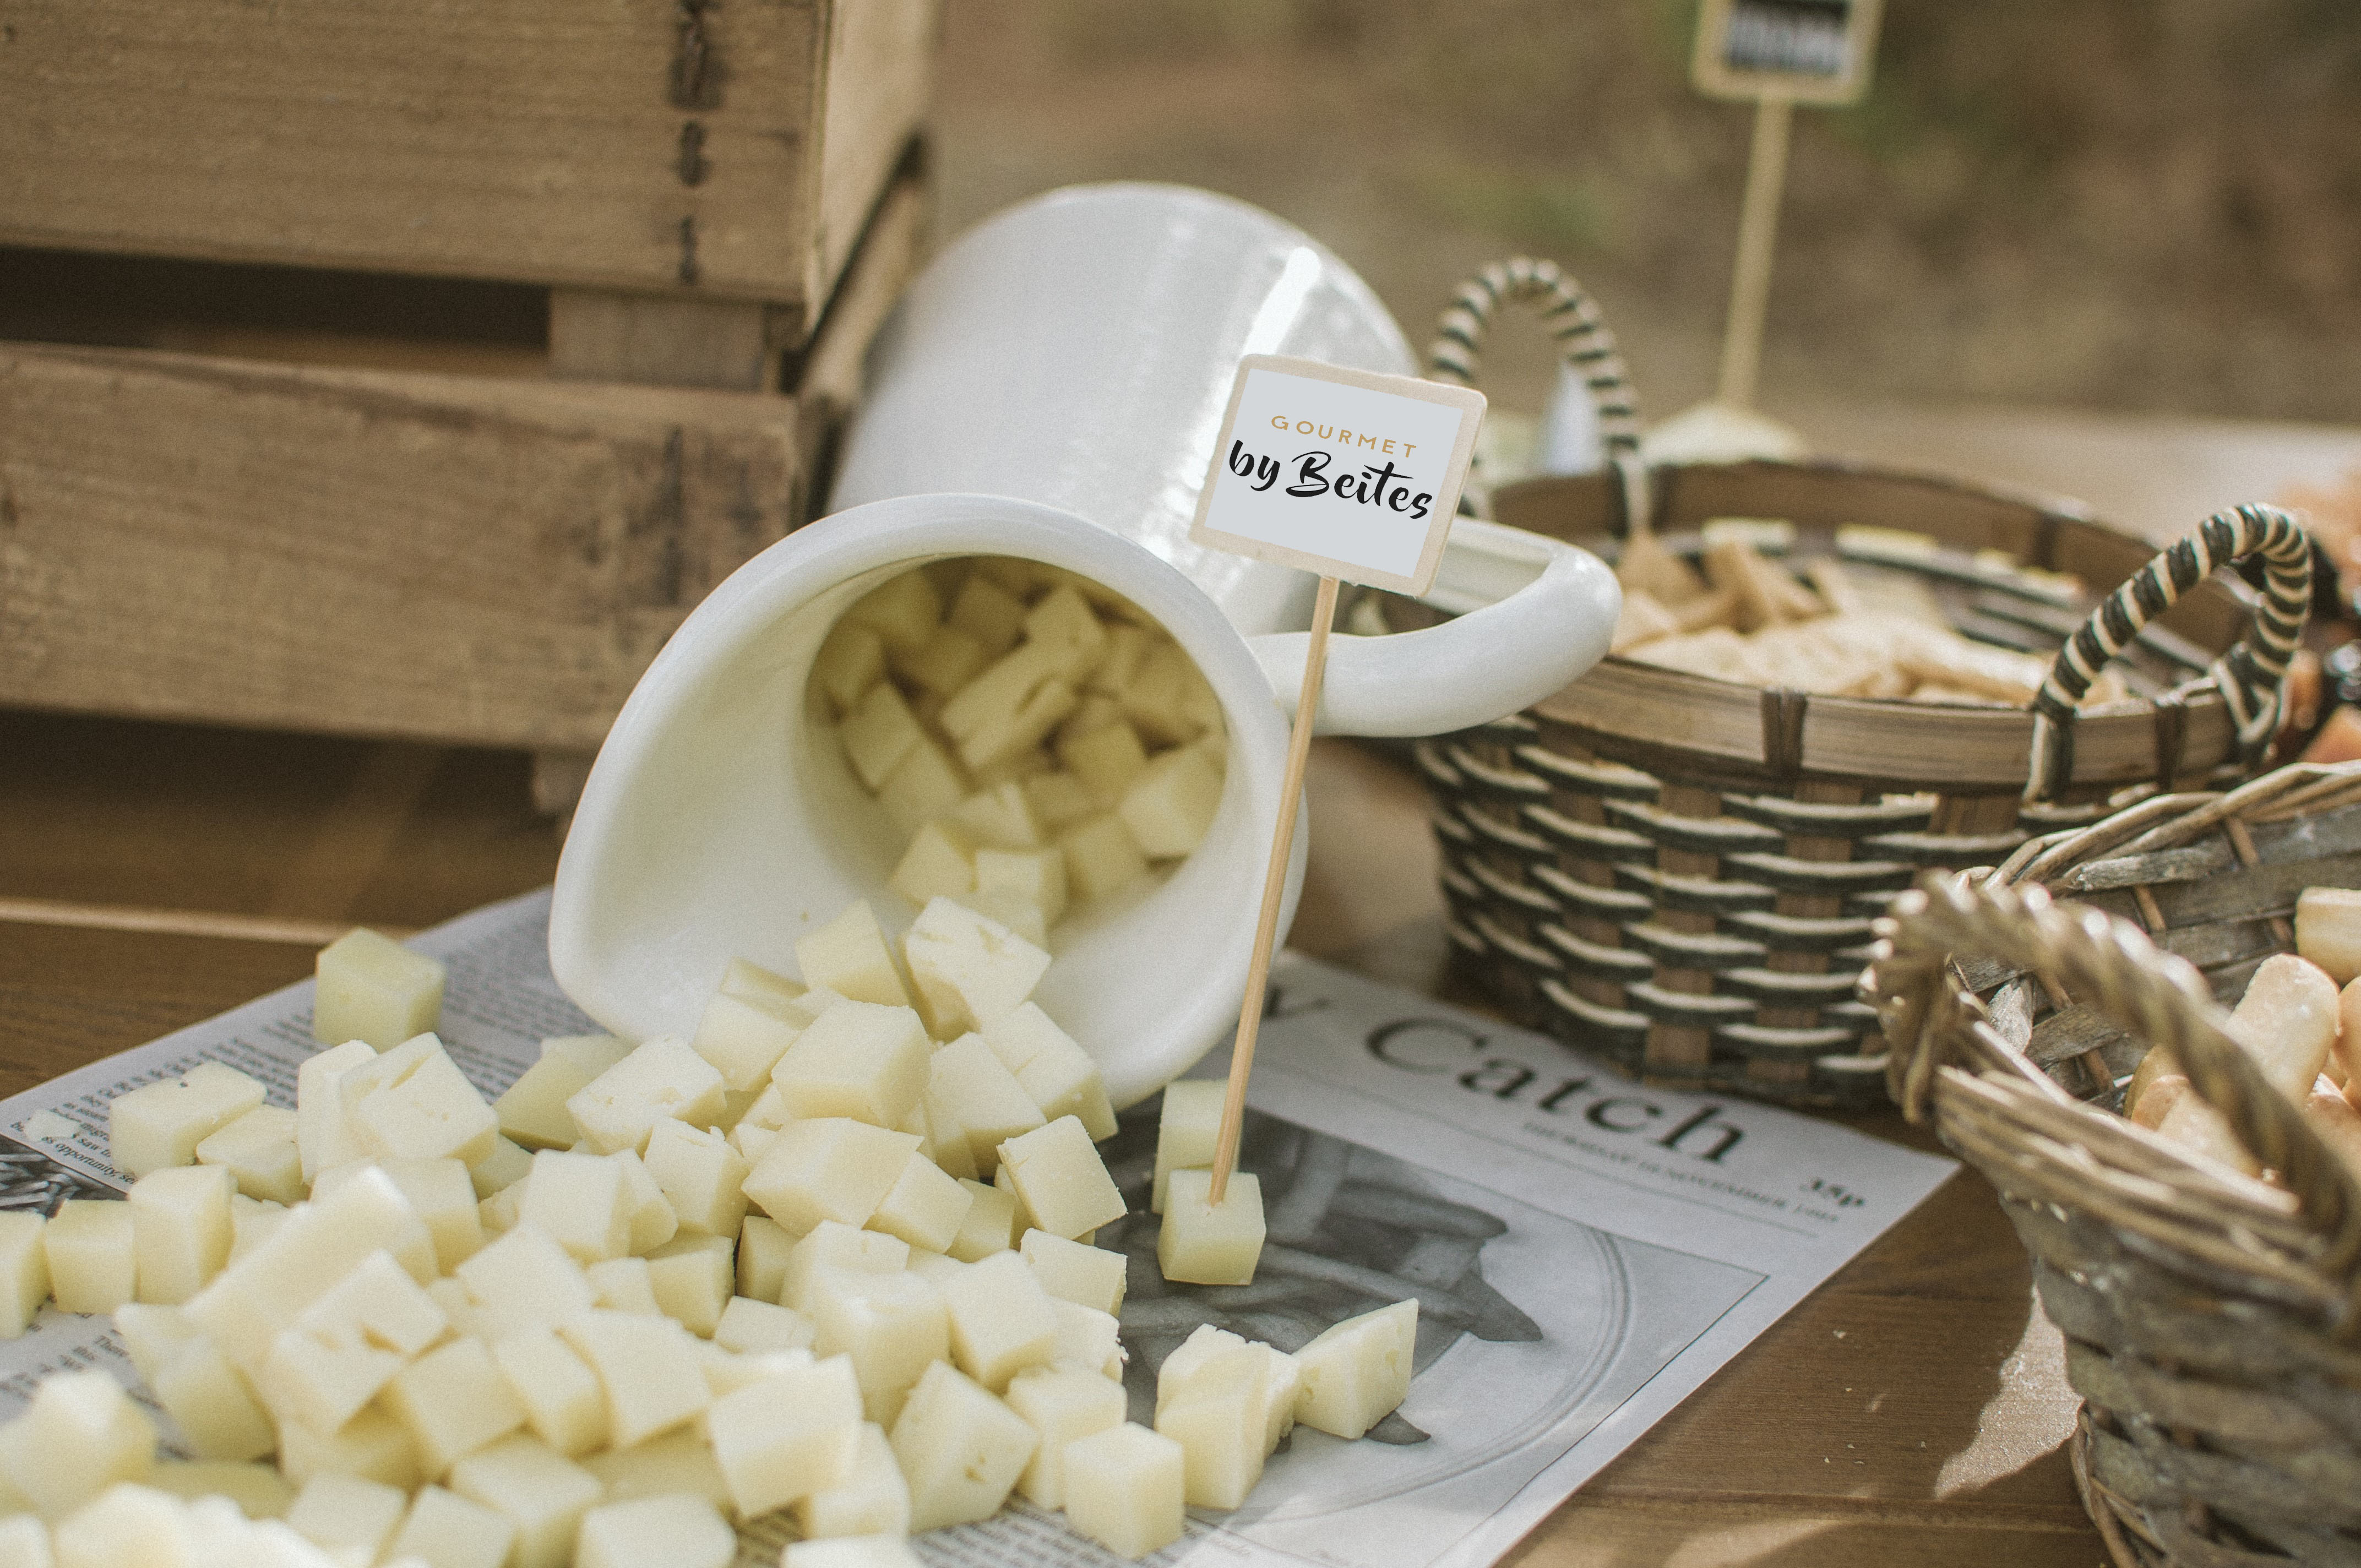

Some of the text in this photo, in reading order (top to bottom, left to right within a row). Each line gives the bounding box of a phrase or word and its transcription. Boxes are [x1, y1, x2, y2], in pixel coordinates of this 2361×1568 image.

[1272, 416, 1416, 458] GOURMET
[1230, 440, 1432, 519] by Beites
[1364, 1017, 1744, 1164] Catch
[56, 1143, 119, 1177] opportunity,
